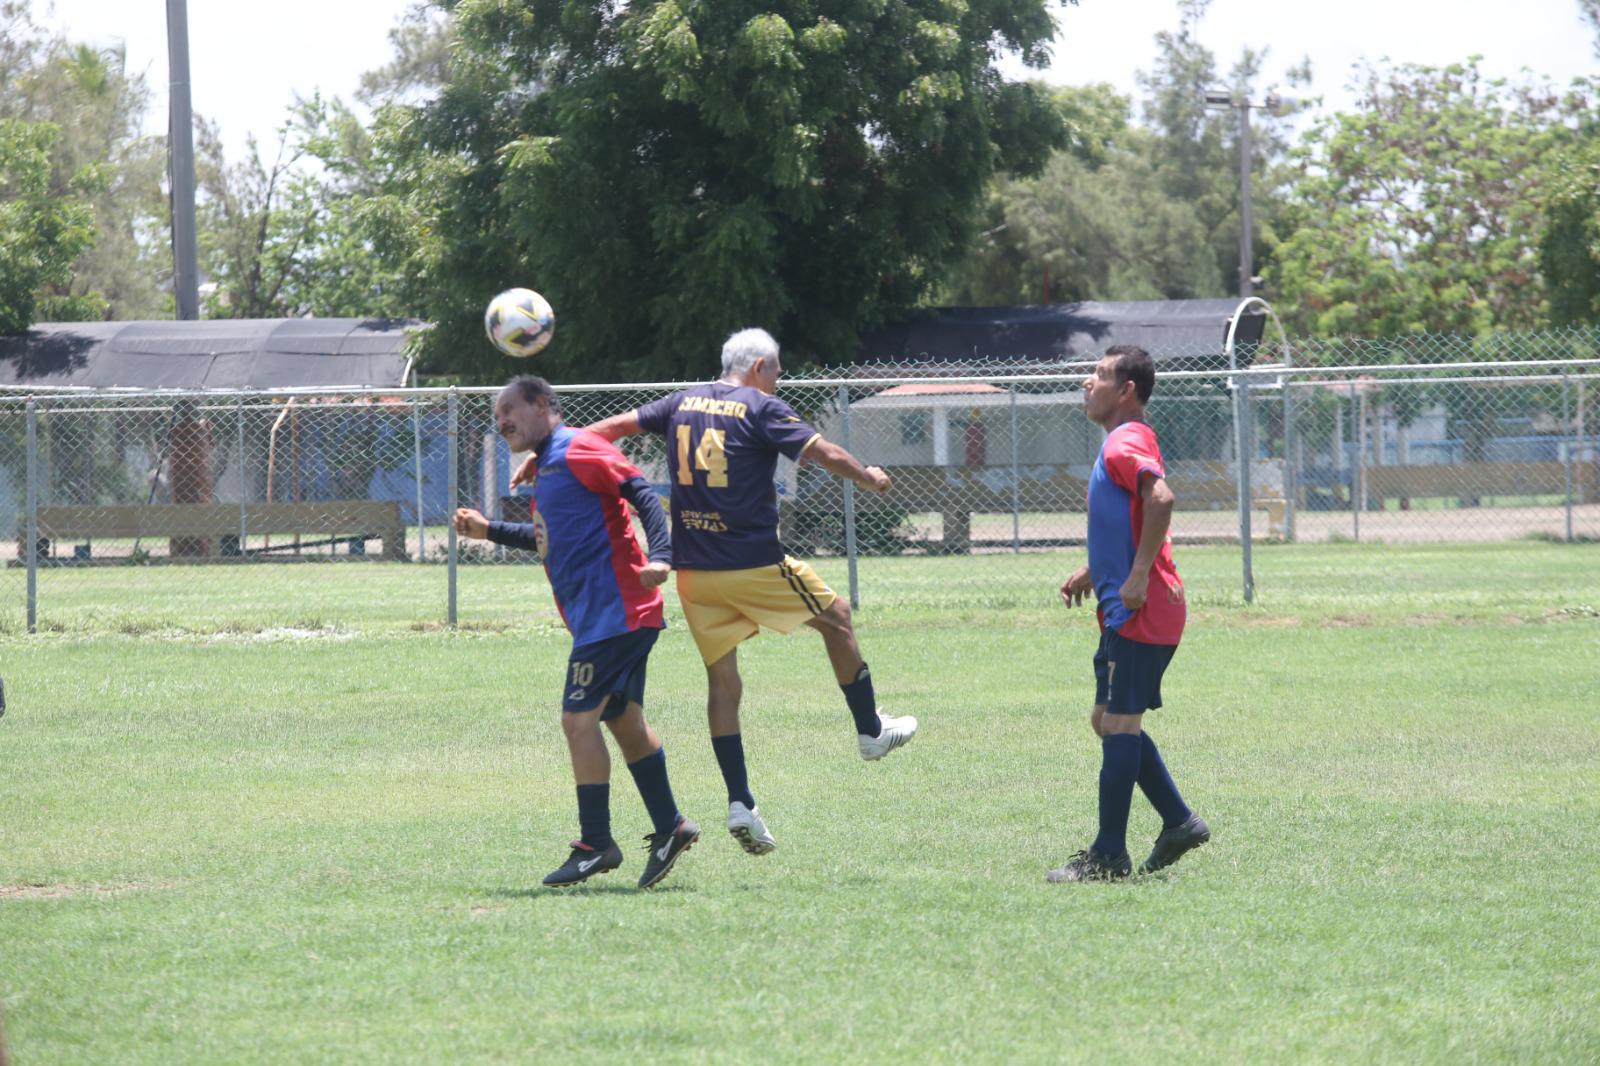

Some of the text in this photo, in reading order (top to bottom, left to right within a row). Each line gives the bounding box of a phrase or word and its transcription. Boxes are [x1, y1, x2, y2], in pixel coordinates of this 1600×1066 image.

[676, 425, 728, 488] 14
[572, 662, 594, 687] 10
[1107, 660, 1116, 686] 7
